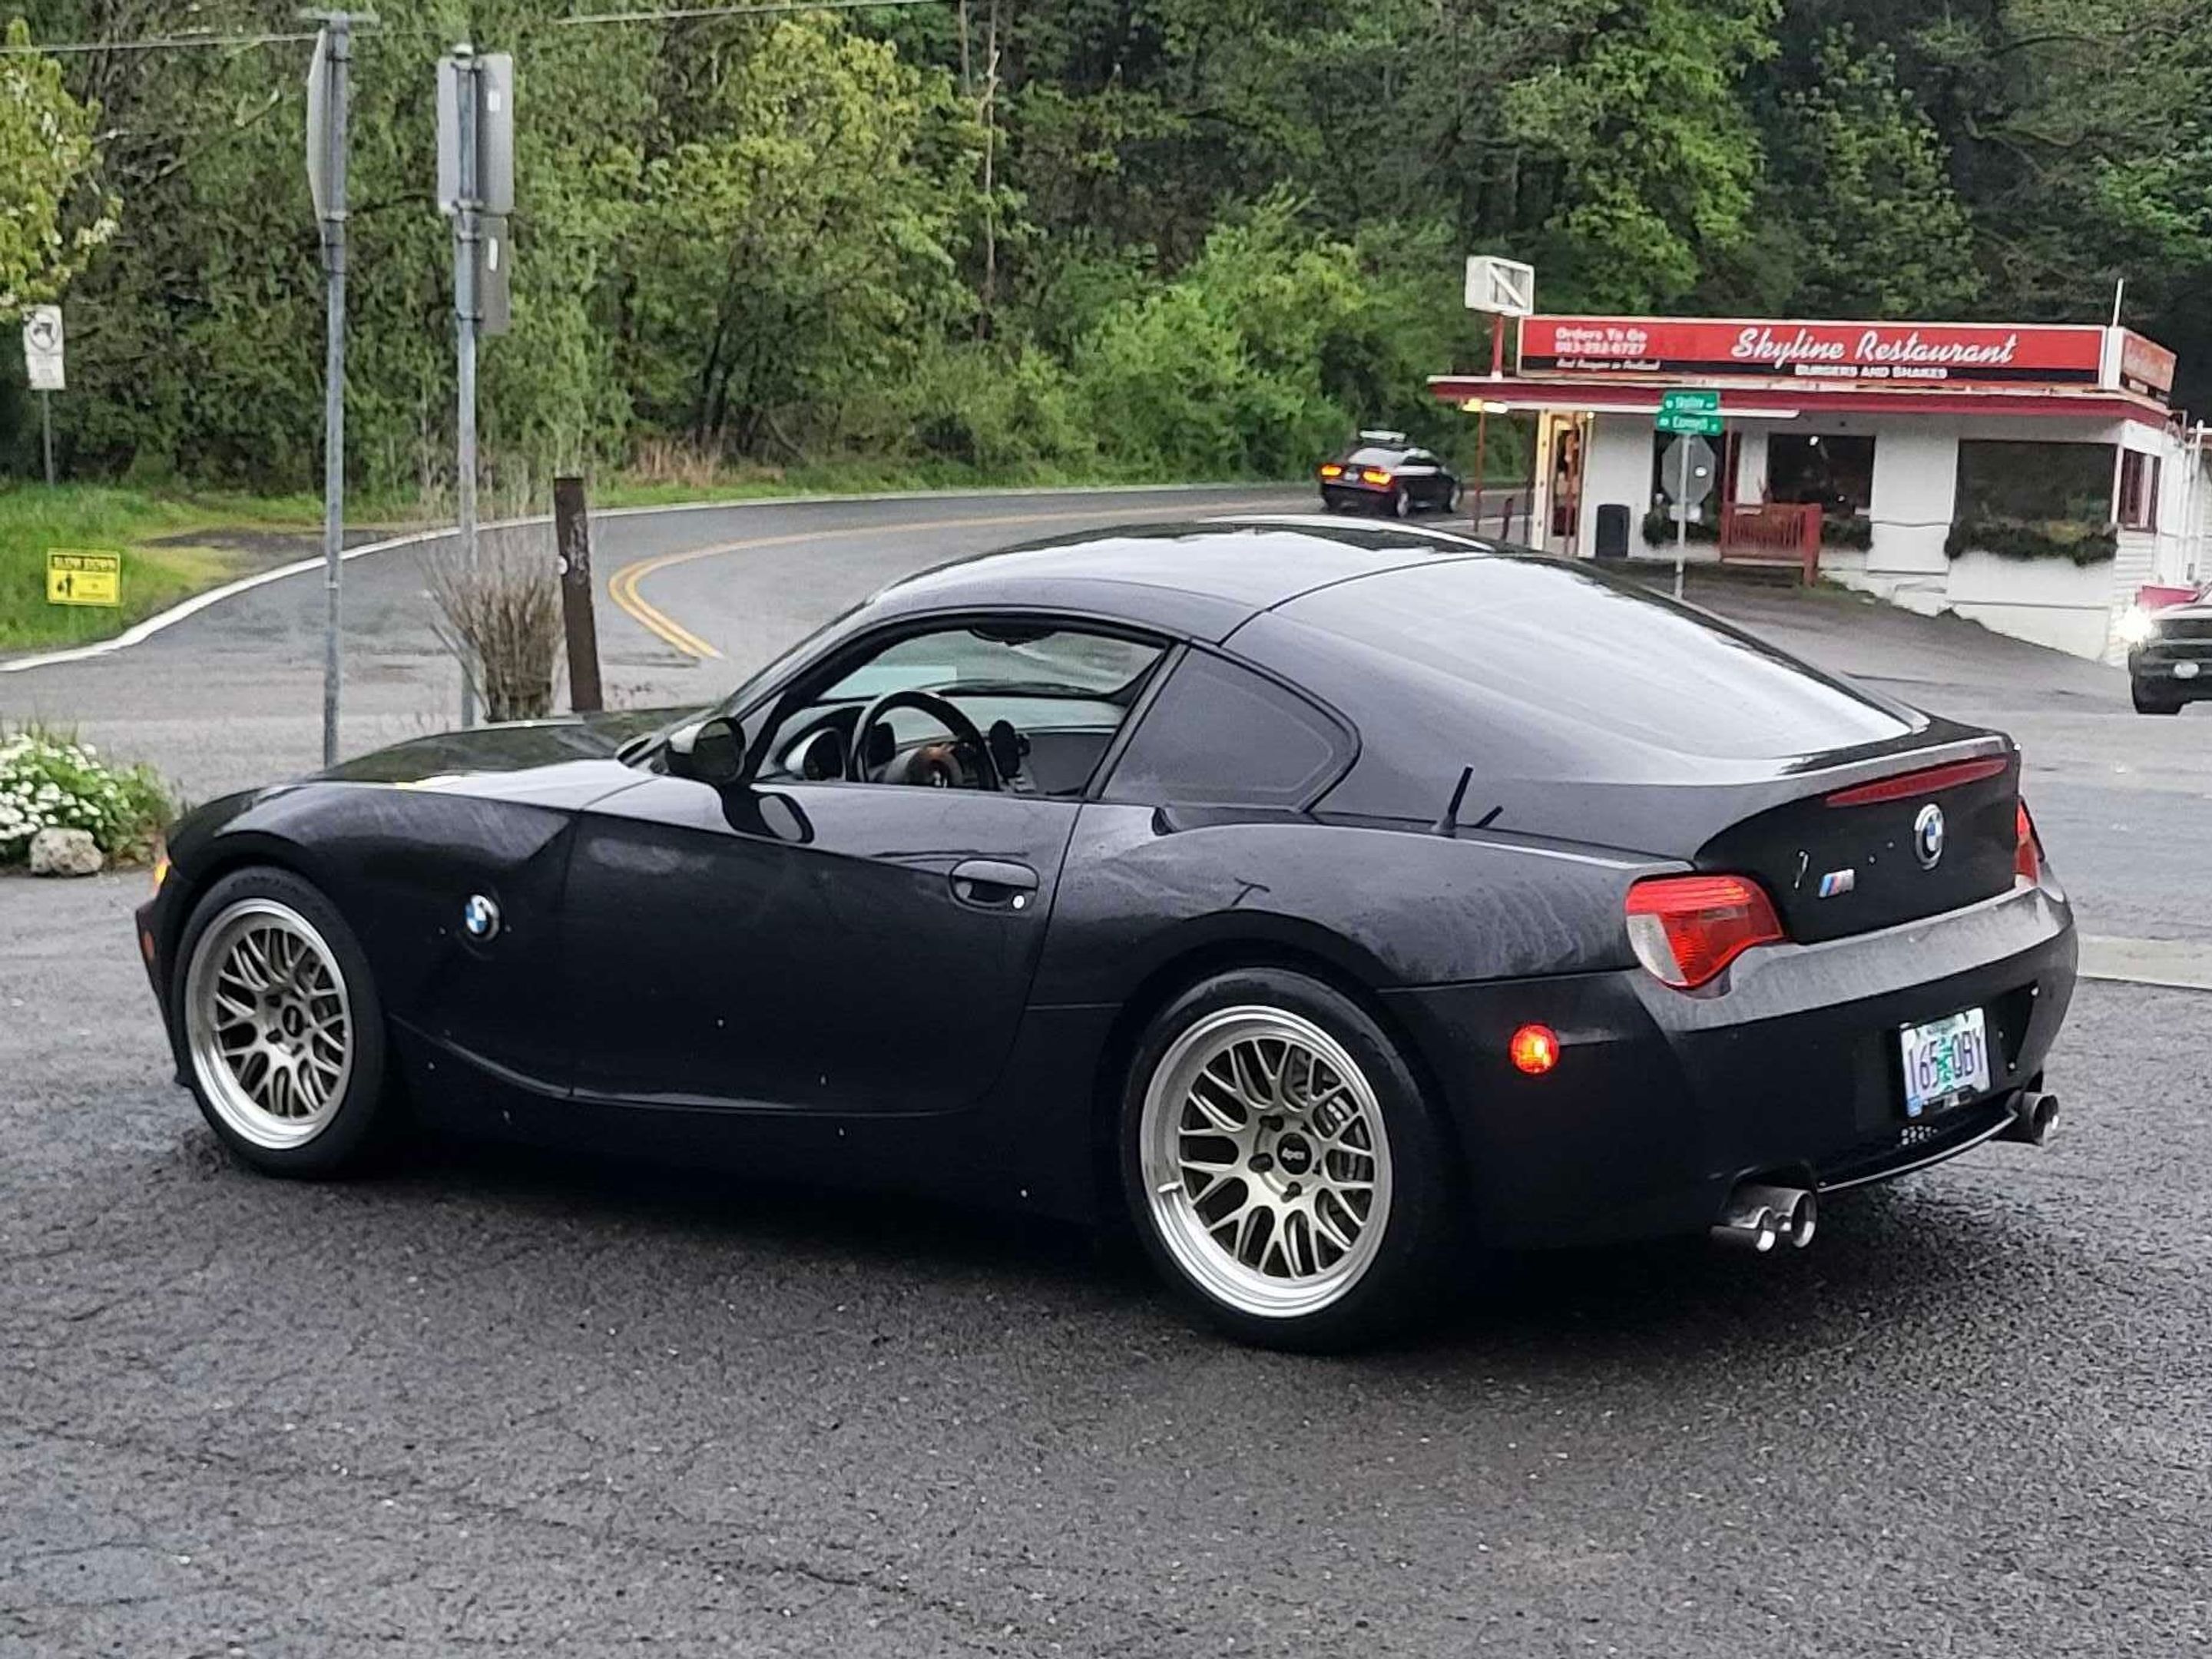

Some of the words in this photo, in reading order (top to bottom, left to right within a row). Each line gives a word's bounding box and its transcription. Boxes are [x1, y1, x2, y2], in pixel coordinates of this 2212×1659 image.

[1731, 327, 1844, 369] Skyline
[1855, 329, 2018, 363] Restaurant
[1860, 366, 1889, 378] AND
[1909, 1040, 1940, 1094] 165
